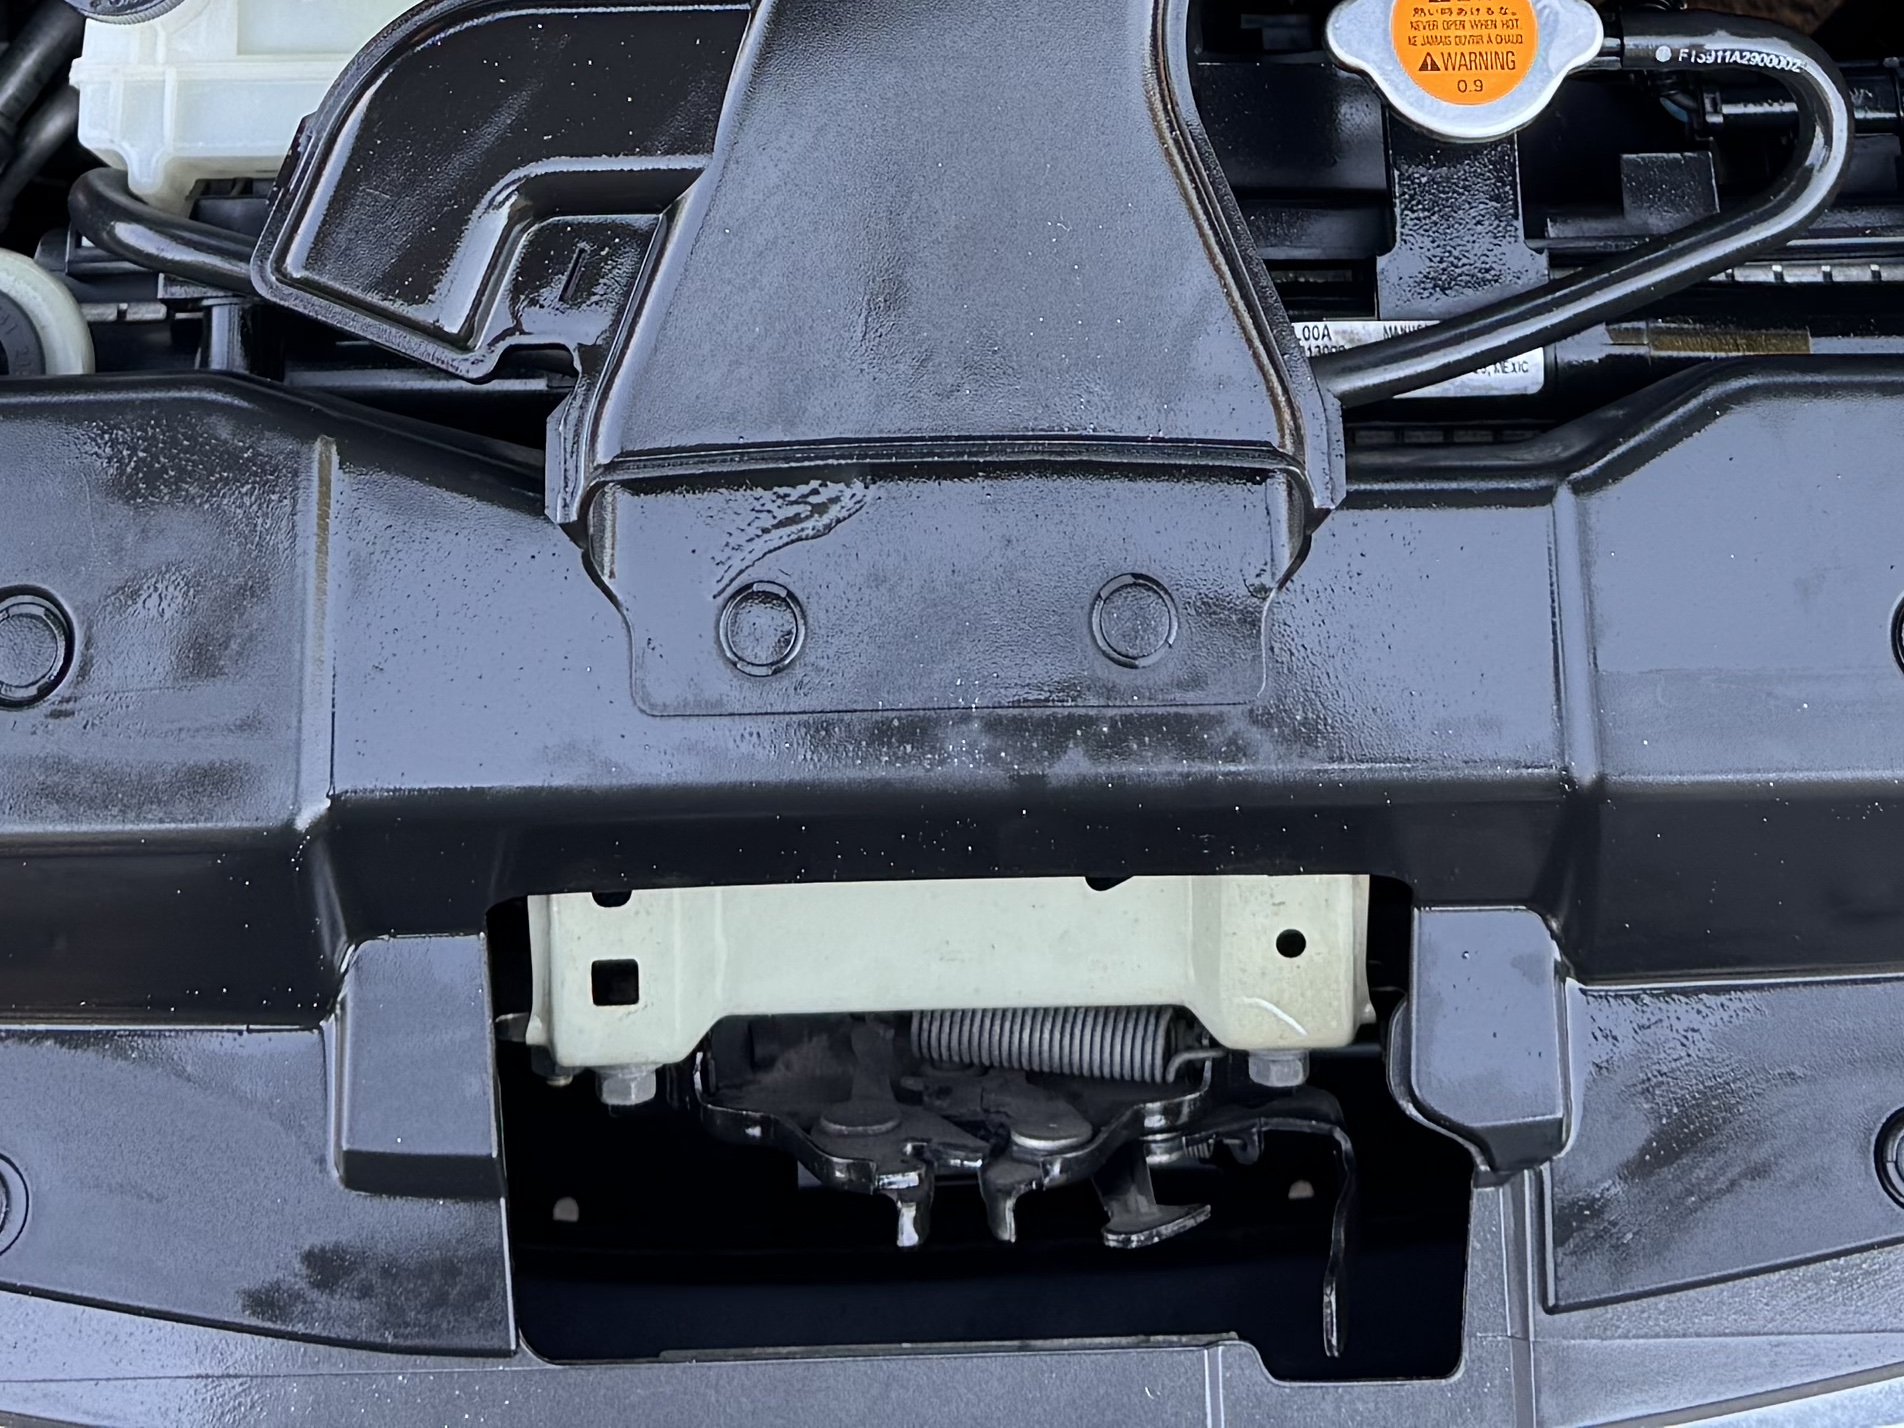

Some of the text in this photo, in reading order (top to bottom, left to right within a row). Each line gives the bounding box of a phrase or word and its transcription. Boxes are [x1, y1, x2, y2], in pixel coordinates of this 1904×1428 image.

[1410, 20, 1438, 31] NEVER
[1443, 19, 1466, 30] OPEN
[1469, 19, 1497, 30] WHEN
[1441, 50, 1516, 72] WARNING
[1457, 79, 1484, 94] 0.9
